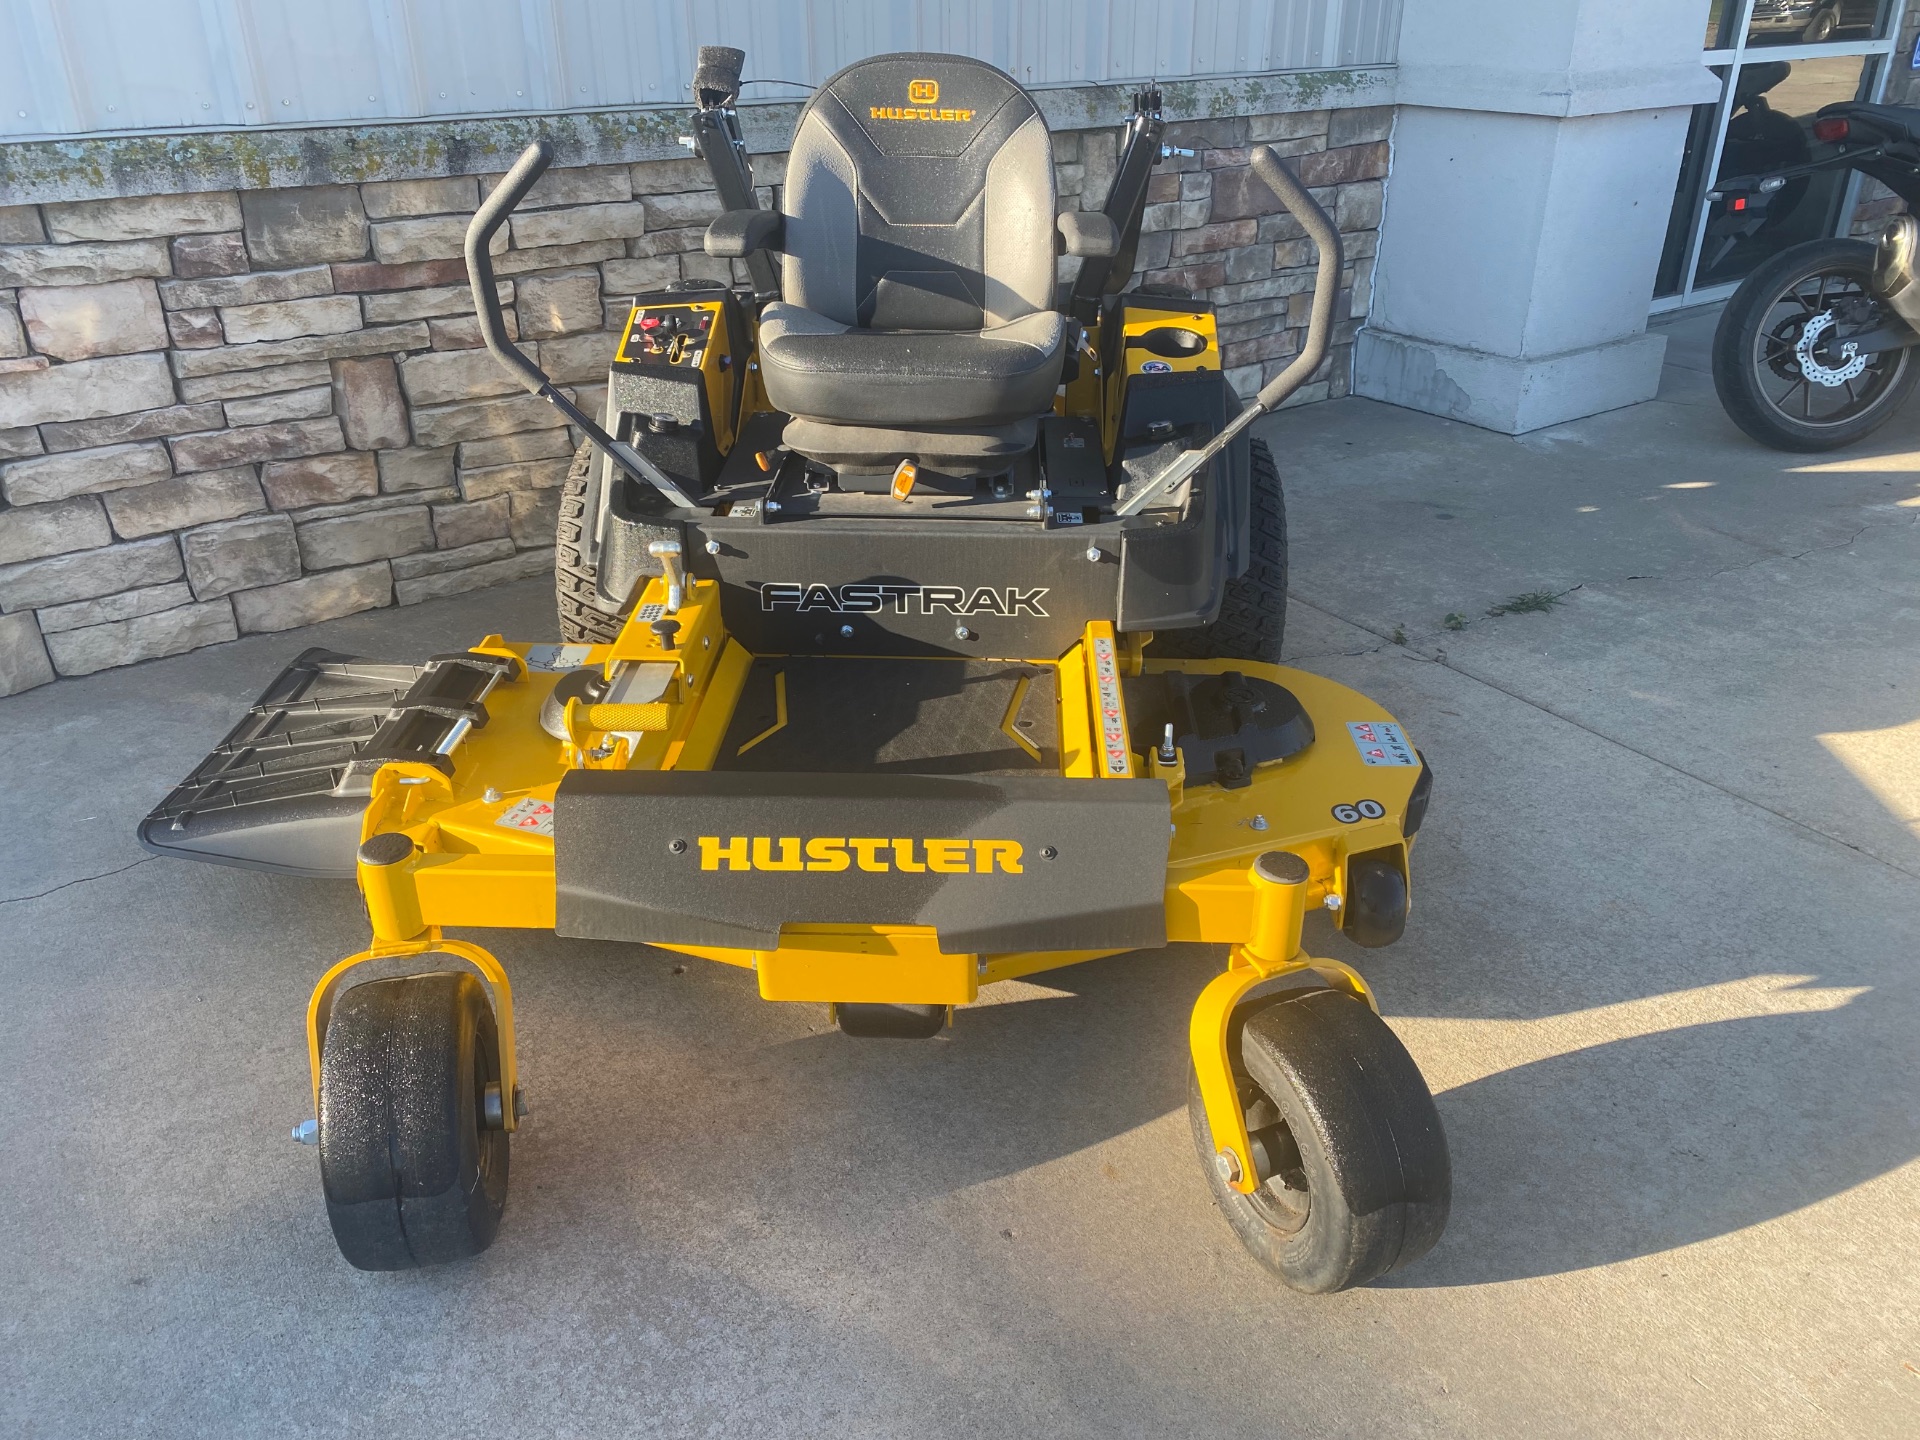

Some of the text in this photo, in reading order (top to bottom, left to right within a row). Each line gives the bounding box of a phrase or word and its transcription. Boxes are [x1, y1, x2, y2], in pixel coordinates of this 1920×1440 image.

[911, 82, 936, 99] H
[869, 106, 972, 121] HUSTLER
[761, 584, 1050, 617] FASTRAK
[1330, 799, 1386, 824] 60
[698, 837, 1023, 874] HUSTLER
